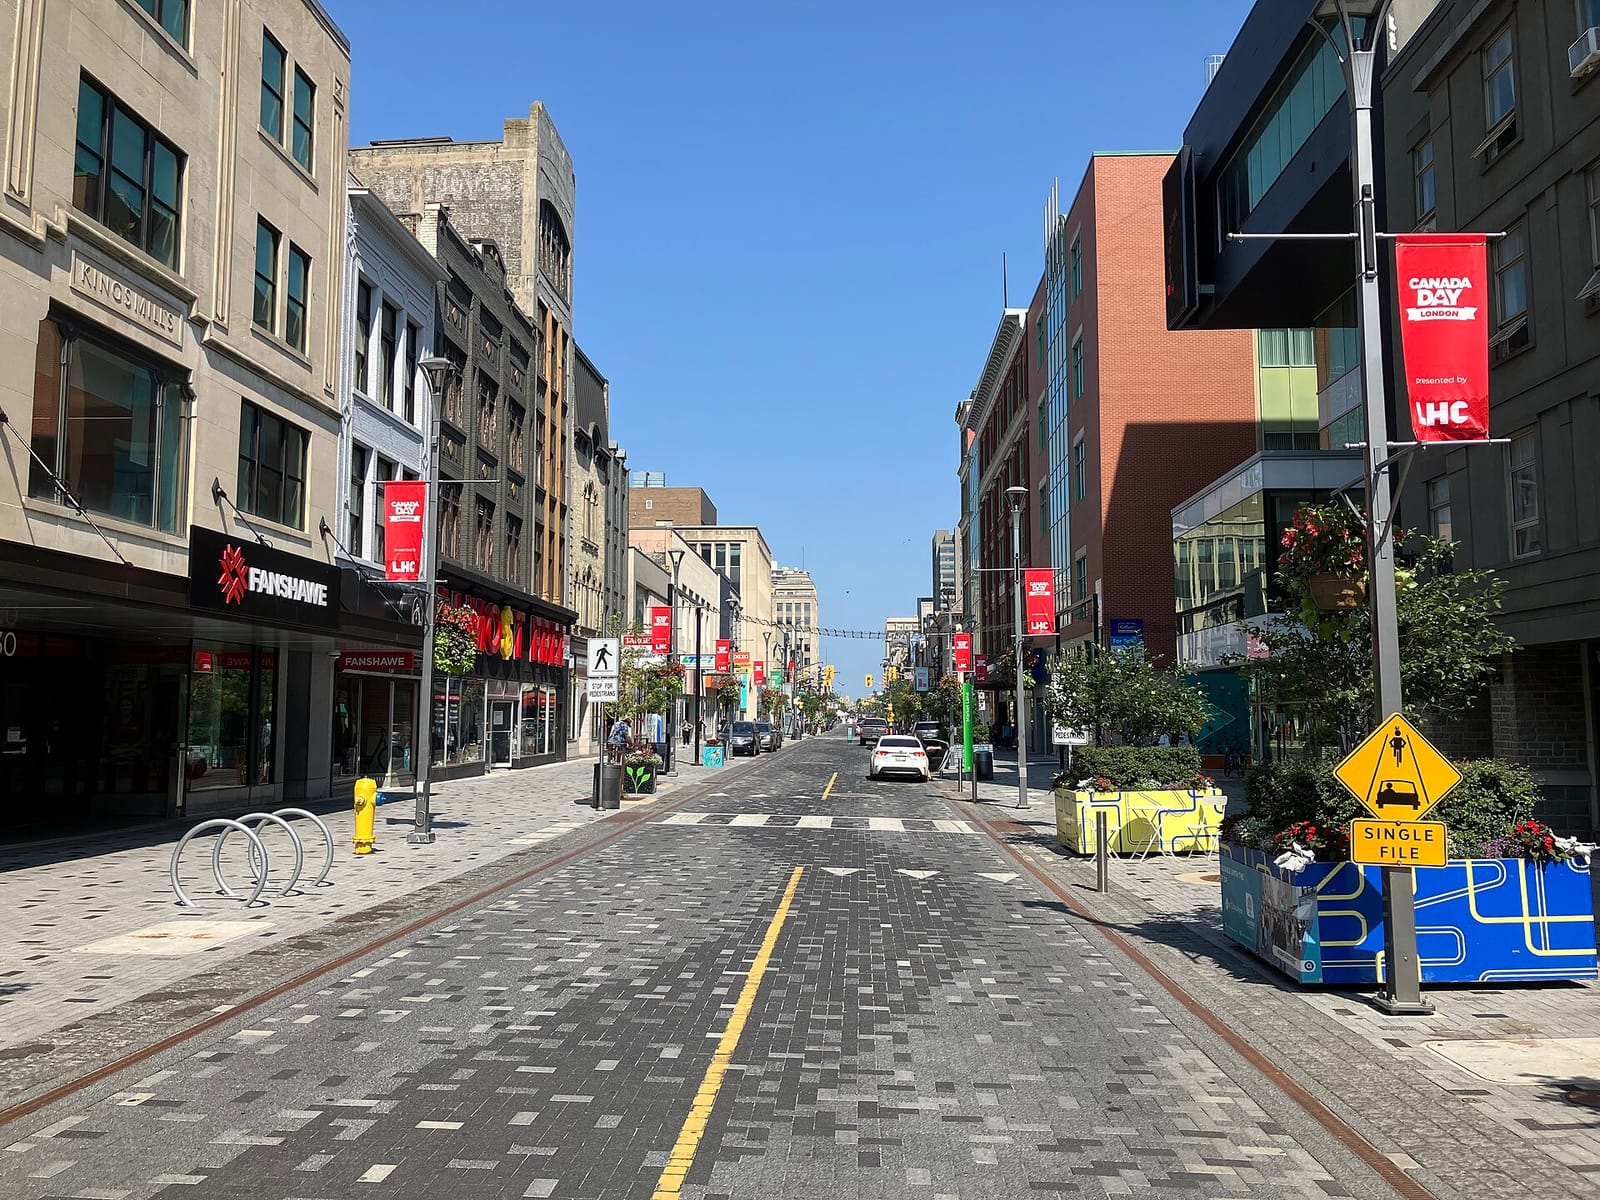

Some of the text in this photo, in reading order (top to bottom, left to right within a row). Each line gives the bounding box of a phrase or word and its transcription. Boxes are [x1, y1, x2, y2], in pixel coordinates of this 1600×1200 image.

[1409, 277, 1472, 288] CANADA
[1416, 288, 1462, 306] DAY
[1420, 310, 1459, 318] LONDON
[1457, 376, 1467, 384] by
[395, 507, 416, 515] DAY
[391, 561, 416, 573] LHC
[248, 566, 328, 607] FANSHAWE
[1031, 622, 1049, 630] LHC
[345, 657, 405, 666] FANSHAWE
[1365, 828, 1434, 841] SINGLE
[1380, 847, 1419, 859] FILE
